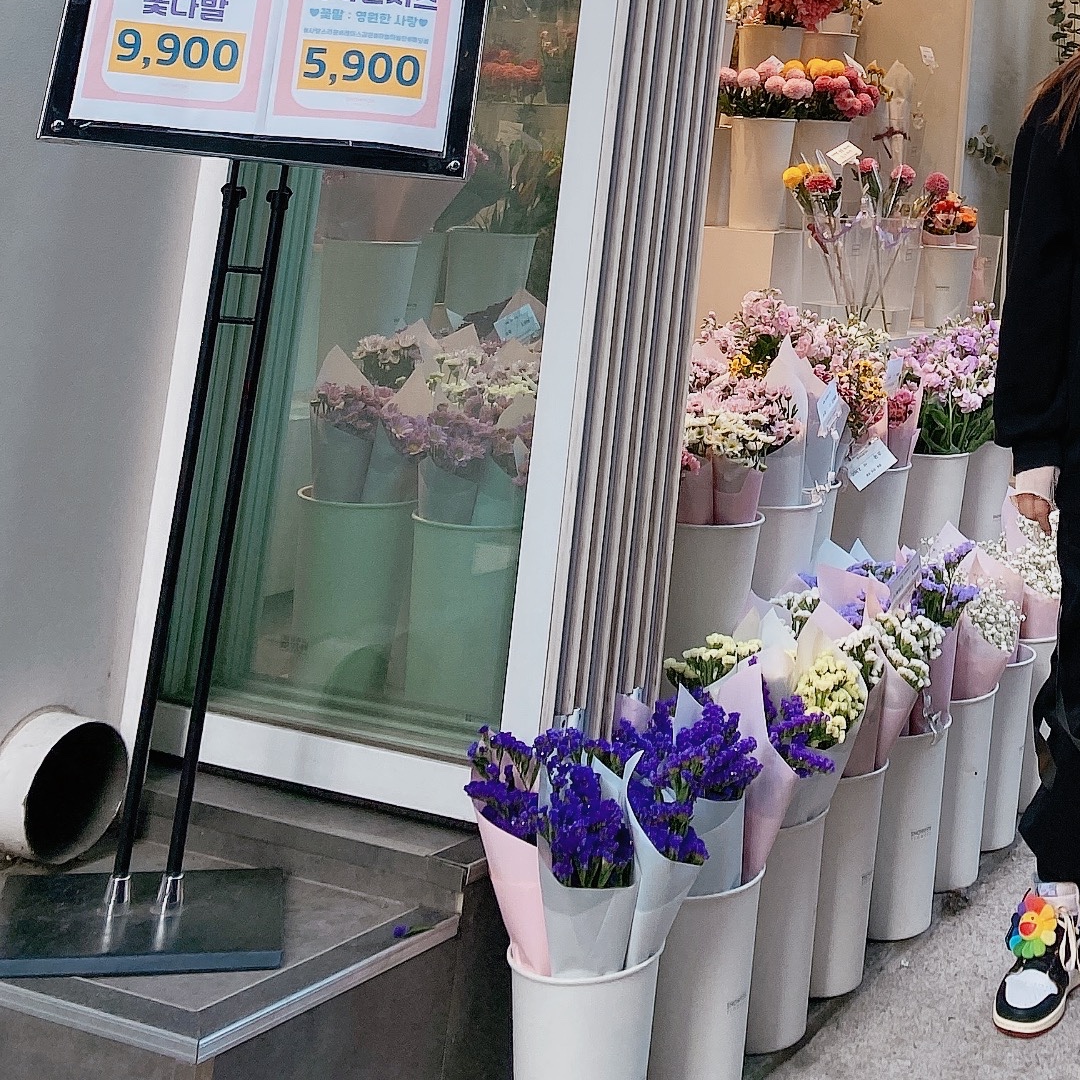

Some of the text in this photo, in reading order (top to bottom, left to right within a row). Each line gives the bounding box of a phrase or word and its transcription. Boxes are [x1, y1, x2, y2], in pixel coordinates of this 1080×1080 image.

[355, 10, 393, 27] 영원한
[394, 14, 419, 29] 사랑
[116, 28, 240, 73] 9,900
[302, 46, 422, 88] 5,900
